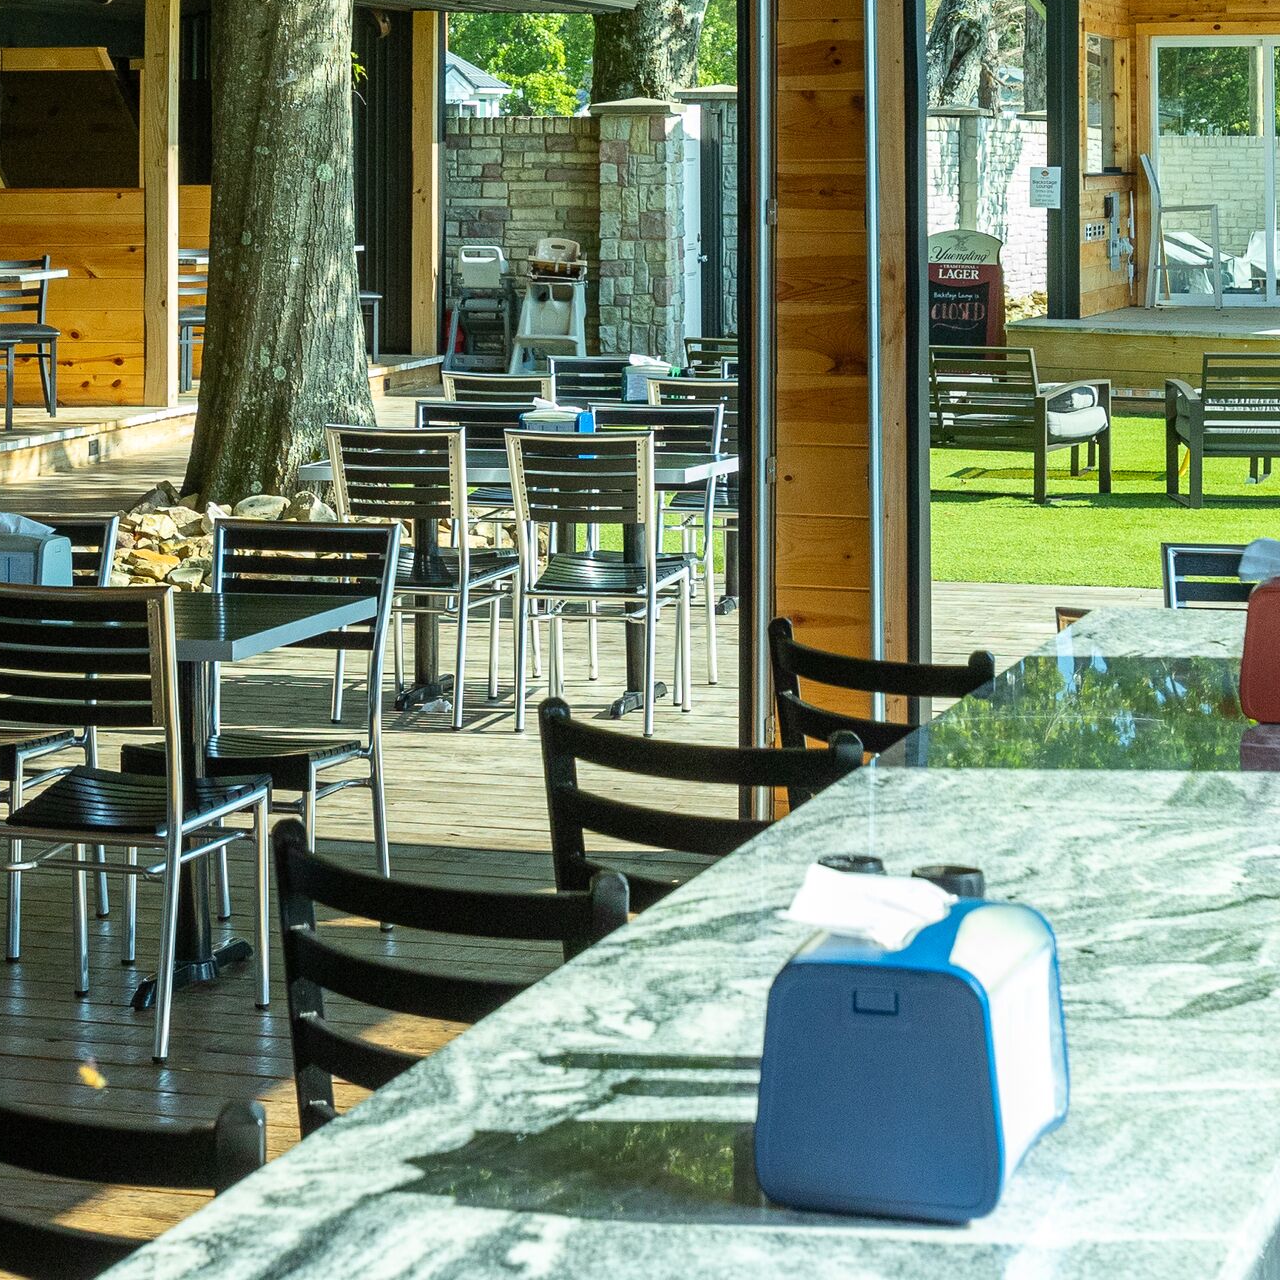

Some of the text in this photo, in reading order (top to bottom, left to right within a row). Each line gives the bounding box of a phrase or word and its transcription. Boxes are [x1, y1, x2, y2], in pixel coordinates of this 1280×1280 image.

[930, 246, 990, 262] Yuengling
[938, 269, 979, 280] LAGER
[931, 302, 985, 320] CLOSED
